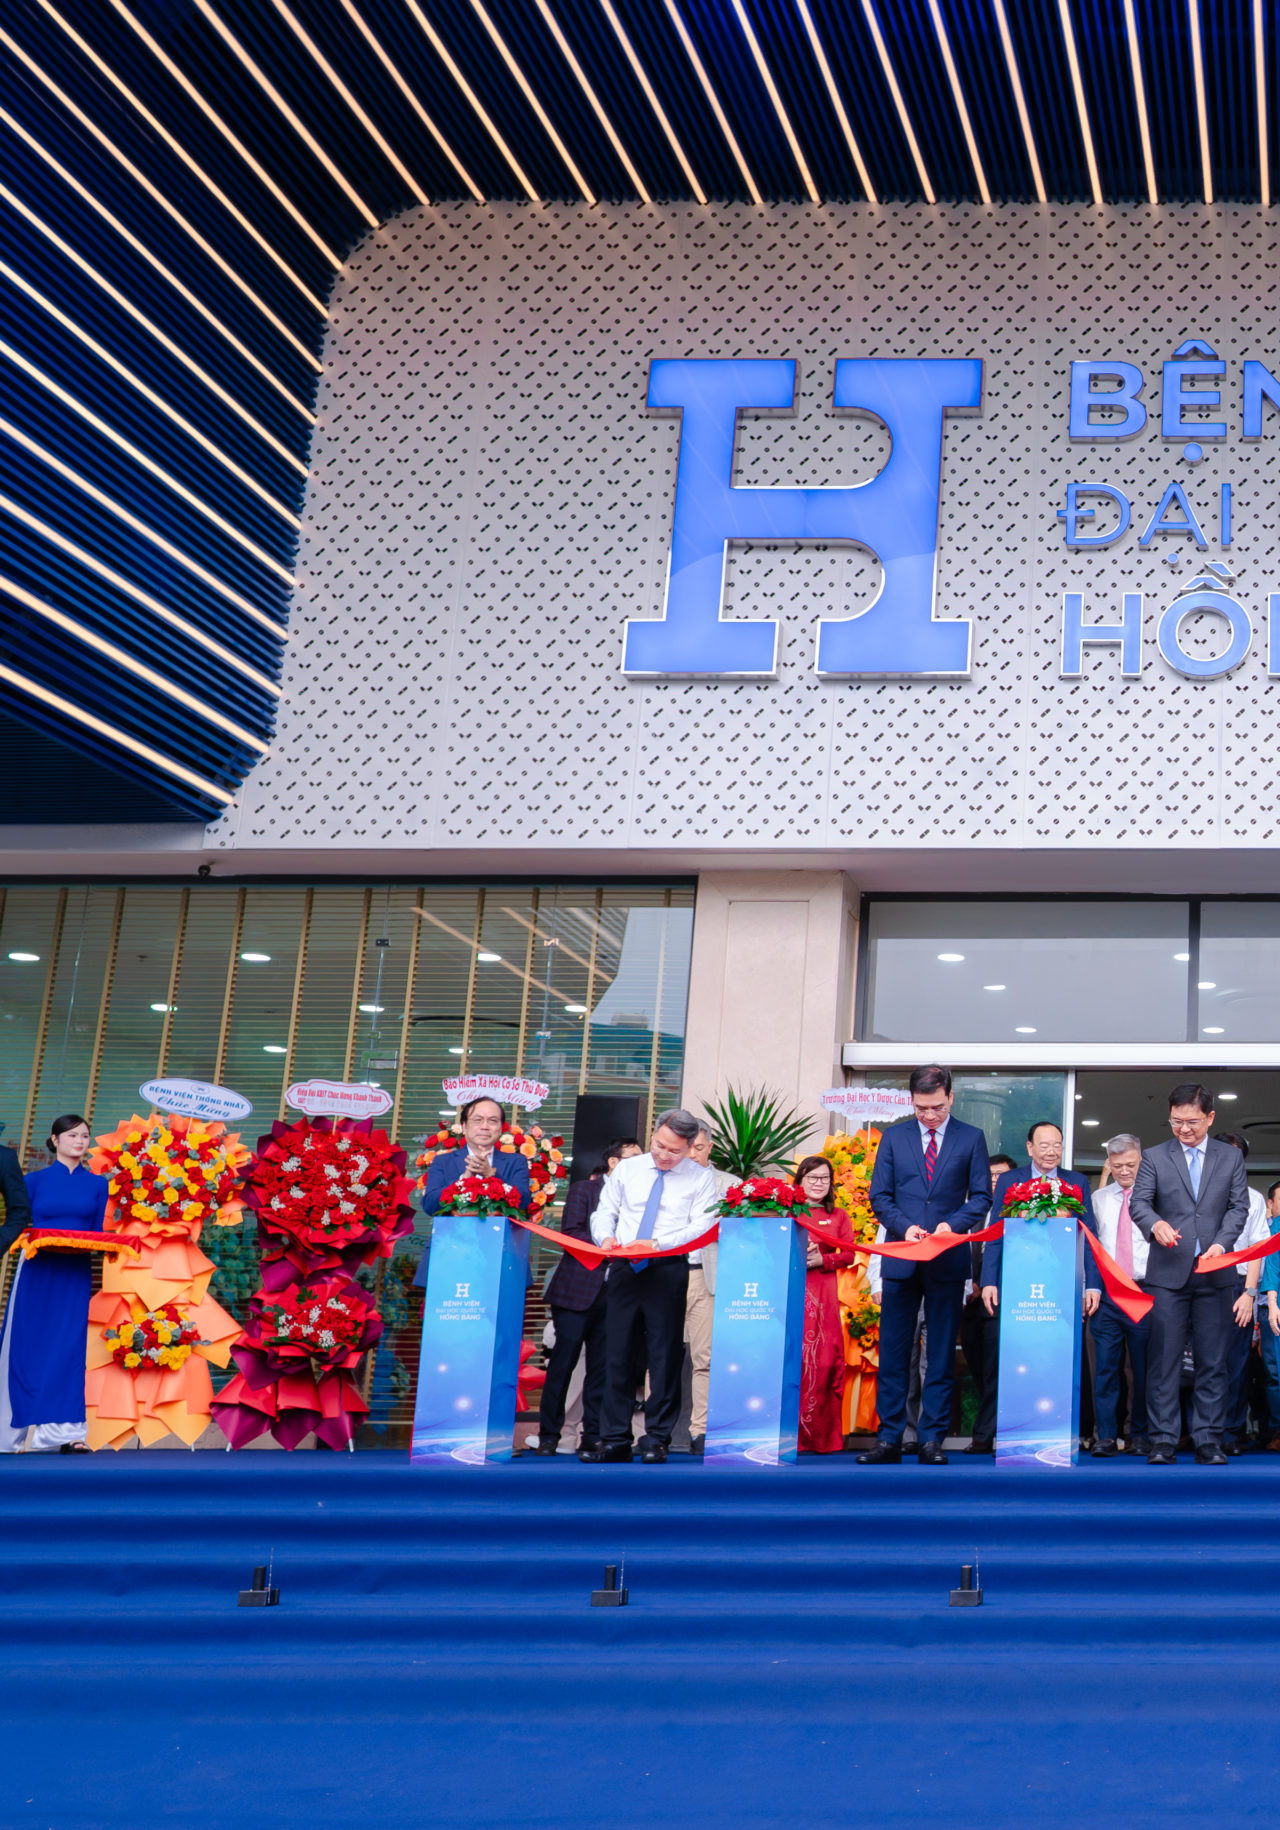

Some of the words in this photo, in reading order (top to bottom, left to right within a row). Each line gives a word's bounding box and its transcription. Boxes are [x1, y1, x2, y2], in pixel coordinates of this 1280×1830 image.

[620, 358, 984, 680] H
[1056, 482, 1233, 568] ĐẠI
[478, 1075, 487, 1088] Xã
[455, 1283, 470, 1297] H
[743, 1283, 759, 1297] H
[1030, 1284, 1045, 1298] H
